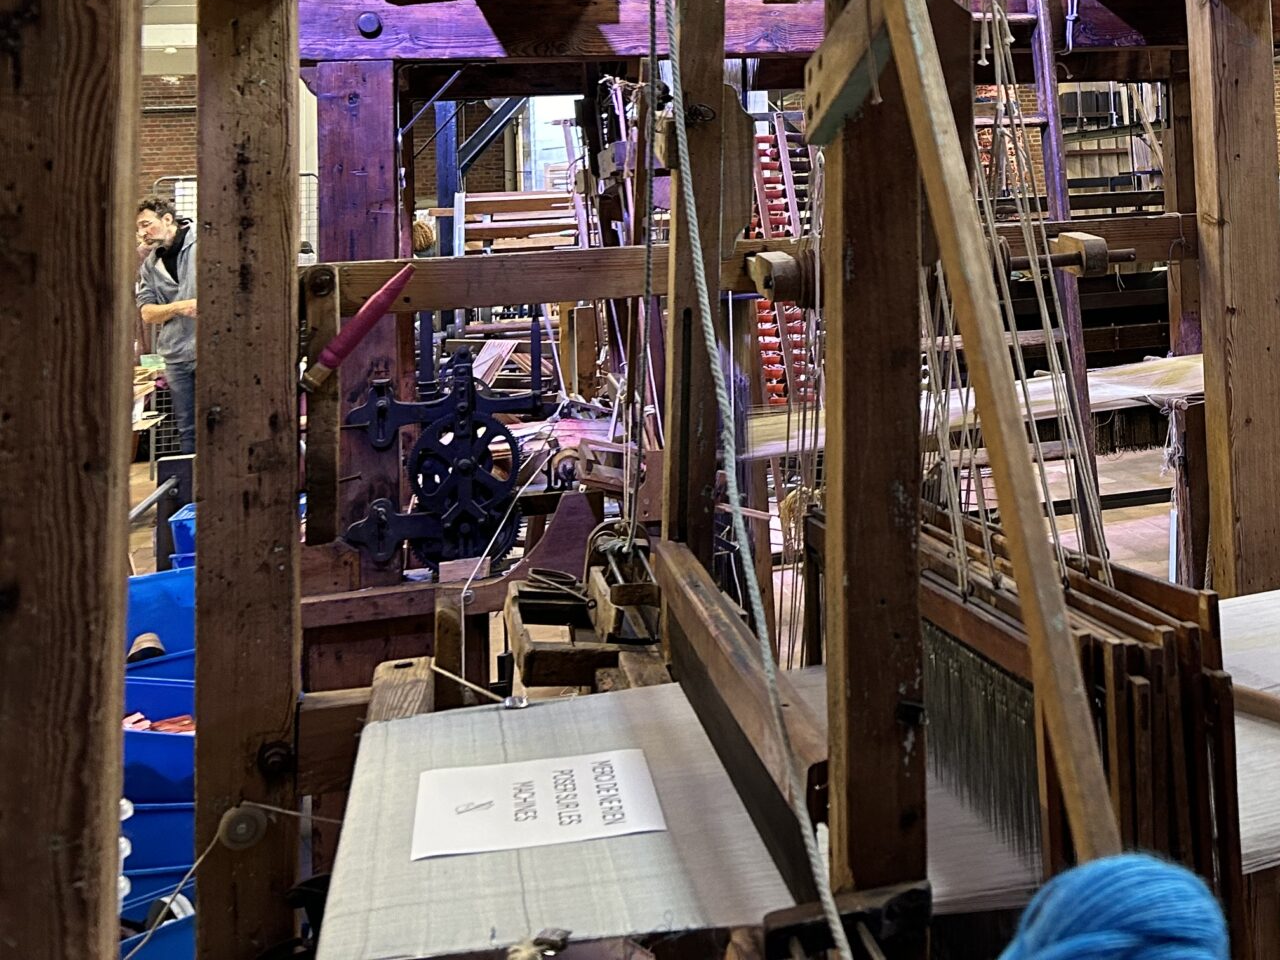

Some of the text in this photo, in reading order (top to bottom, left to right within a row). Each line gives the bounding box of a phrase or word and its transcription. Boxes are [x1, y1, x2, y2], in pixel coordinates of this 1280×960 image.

[512, 781, 538, 822] MACHINES
[552, 769, 582, 826] POSER SUR LES
[591, 760, 626, 825] MERCI DE NE RIEN
